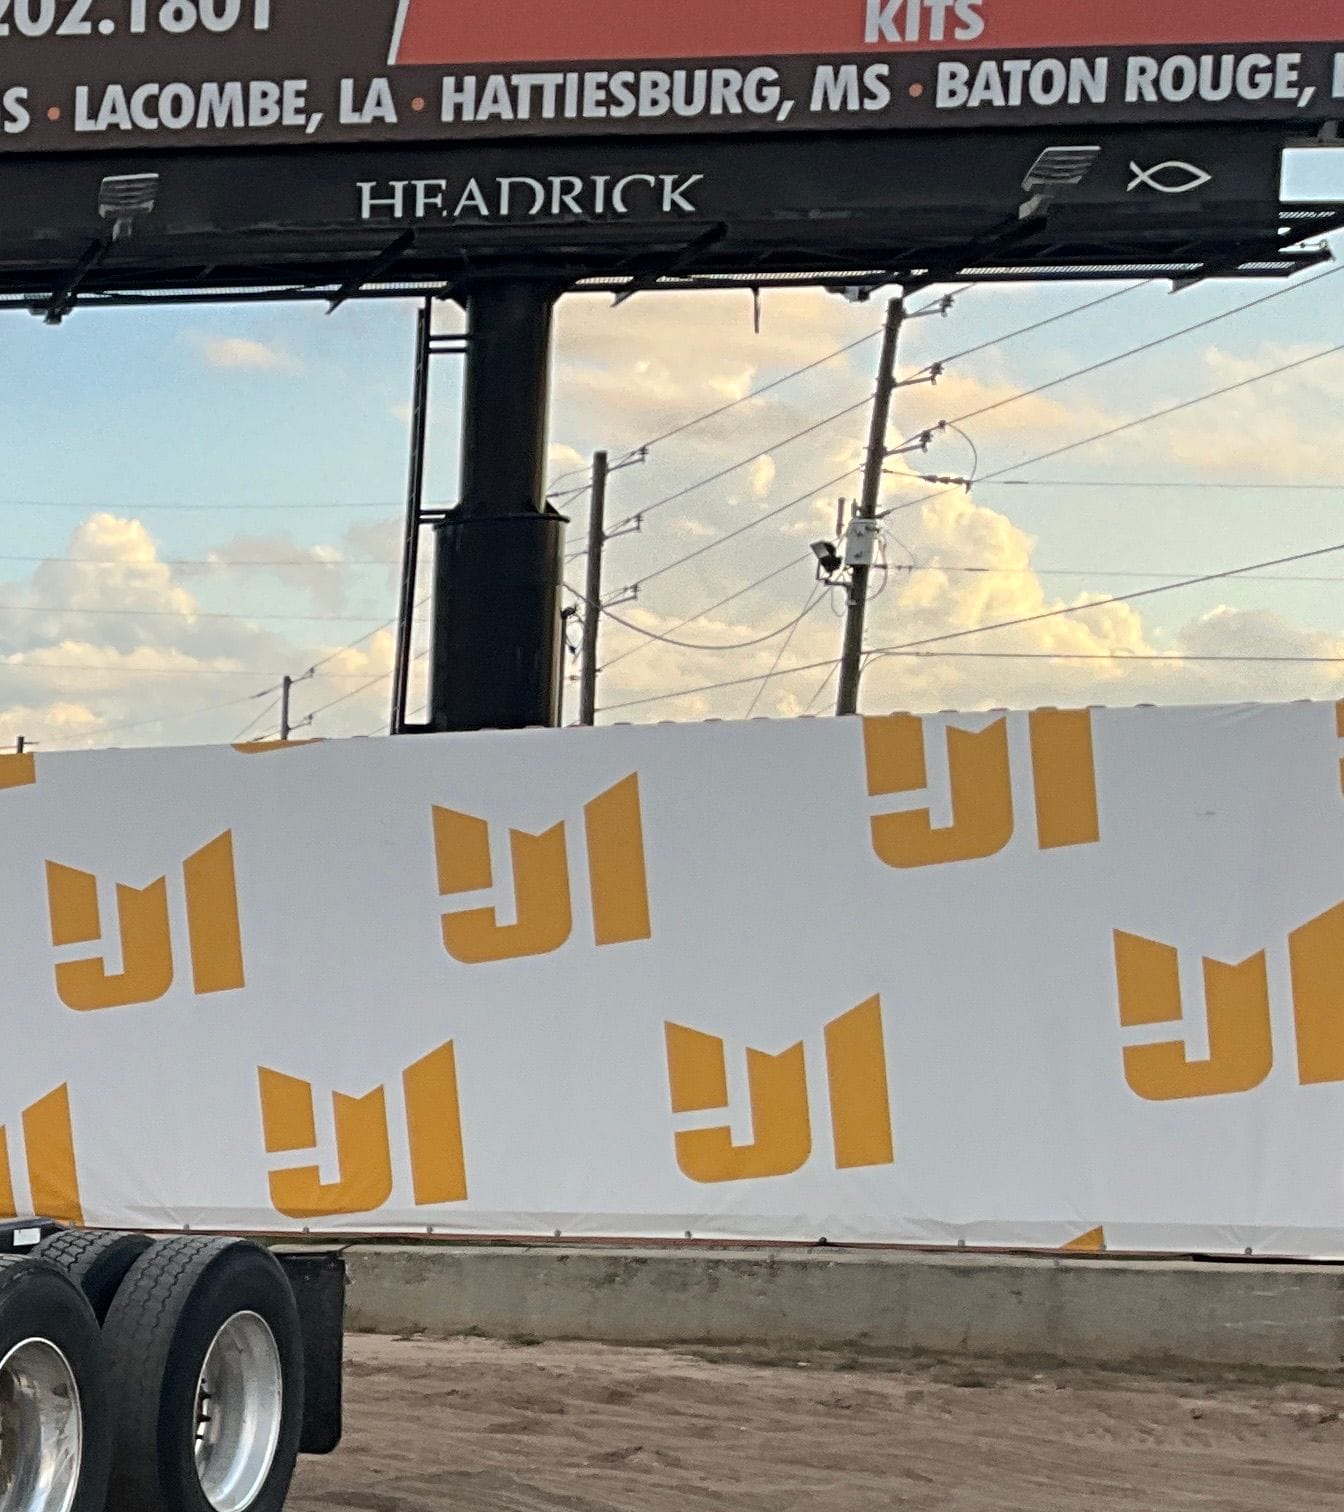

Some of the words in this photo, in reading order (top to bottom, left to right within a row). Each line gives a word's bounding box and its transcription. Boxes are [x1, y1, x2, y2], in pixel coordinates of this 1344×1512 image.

[864, 0, 985, 43] KITS
[75, 79, 324, 133] LACOMBE,
[339, 77, 398, 124] LA
[441, 66, 795, 122] HATTIESBURG,
[810, 63, 891, 111] MS
[936, 56, 1109, 108] BATON
[1124, 52, 1317, 107] ROUGE,
[356, 174, 704, 218] HEADRICK
